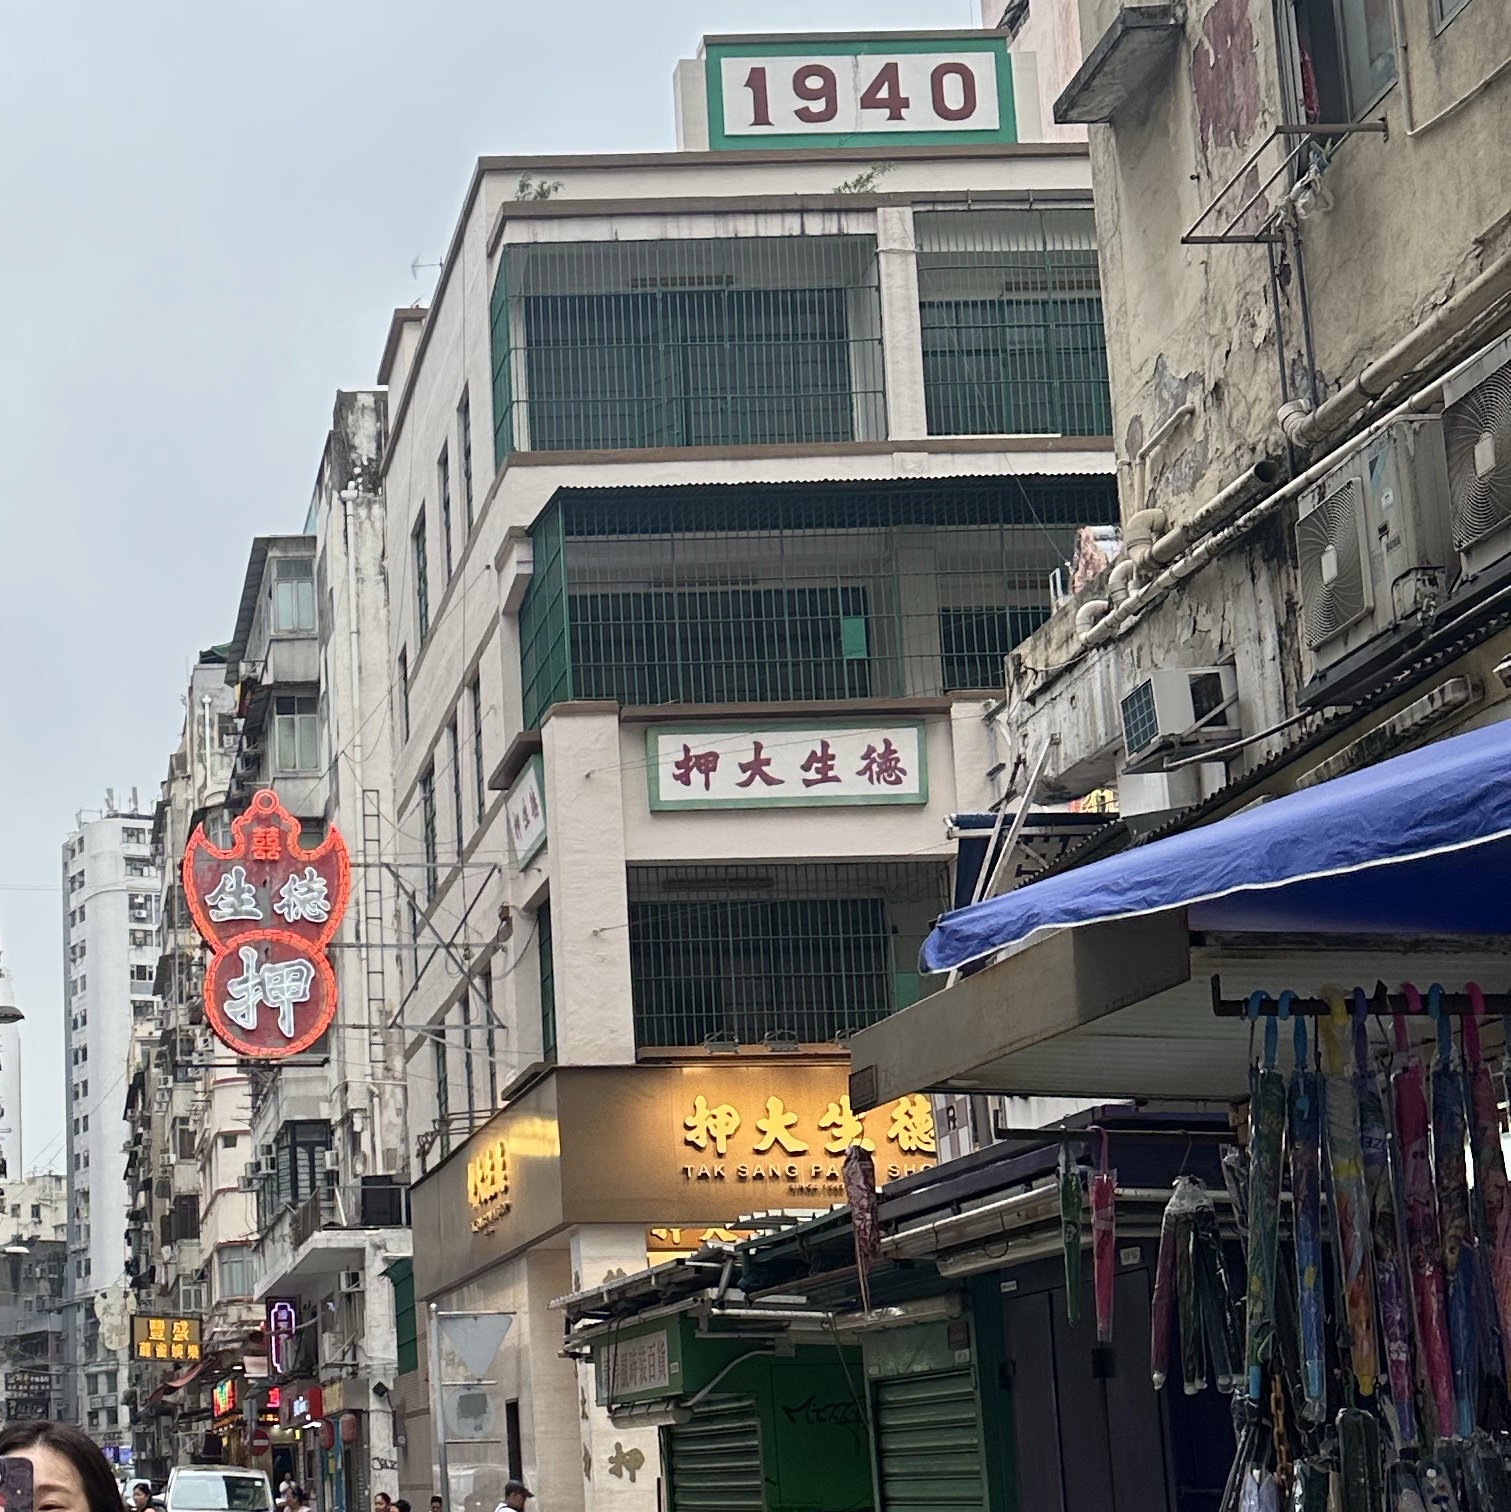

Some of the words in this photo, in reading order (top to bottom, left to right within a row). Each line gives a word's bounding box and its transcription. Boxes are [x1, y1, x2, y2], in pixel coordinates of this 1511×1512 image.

[744, 61, 977, 126] 1940
[223, 946, 316, 1038] 押
[682, 1164, 726, 1178] TAK
[737, 1164, 799, 1178] SANG
[810, 1164, 840, 1178] PA
[888, 1163, 934, 1177] SH
